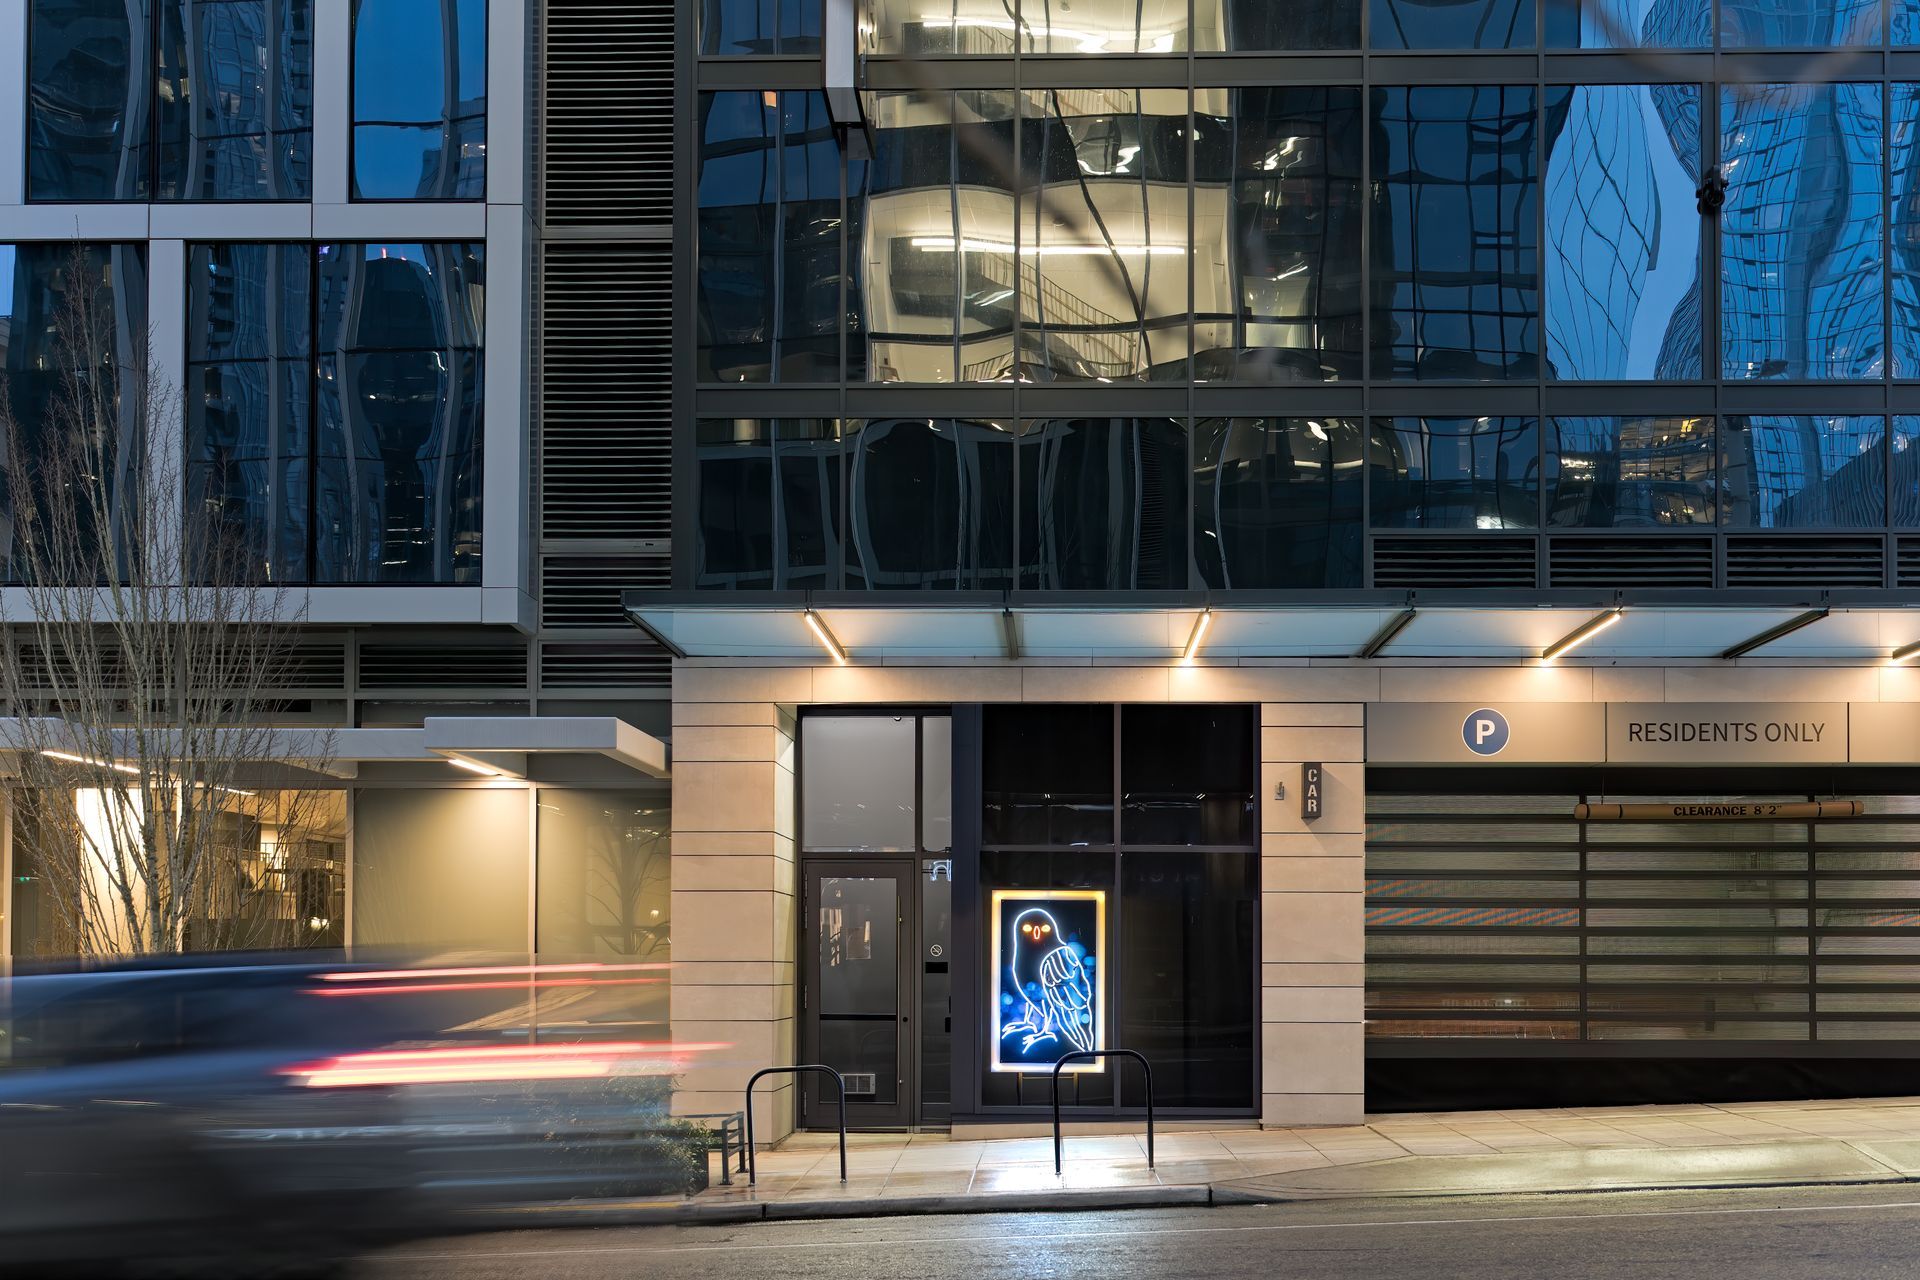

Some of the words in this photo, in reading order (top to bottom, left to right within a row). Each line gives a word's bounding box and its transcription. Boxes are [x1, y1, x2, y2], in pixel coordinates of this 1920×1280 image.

[1476, 719, 1496, 745] P
[1629, 722, 1757, 742] RESIDENTS
[1764, 722, 1825, 742] ONLY
[1307, 768, 1318, 813] CAR
[1673, 806, 1747, 816] CLEARANCE
